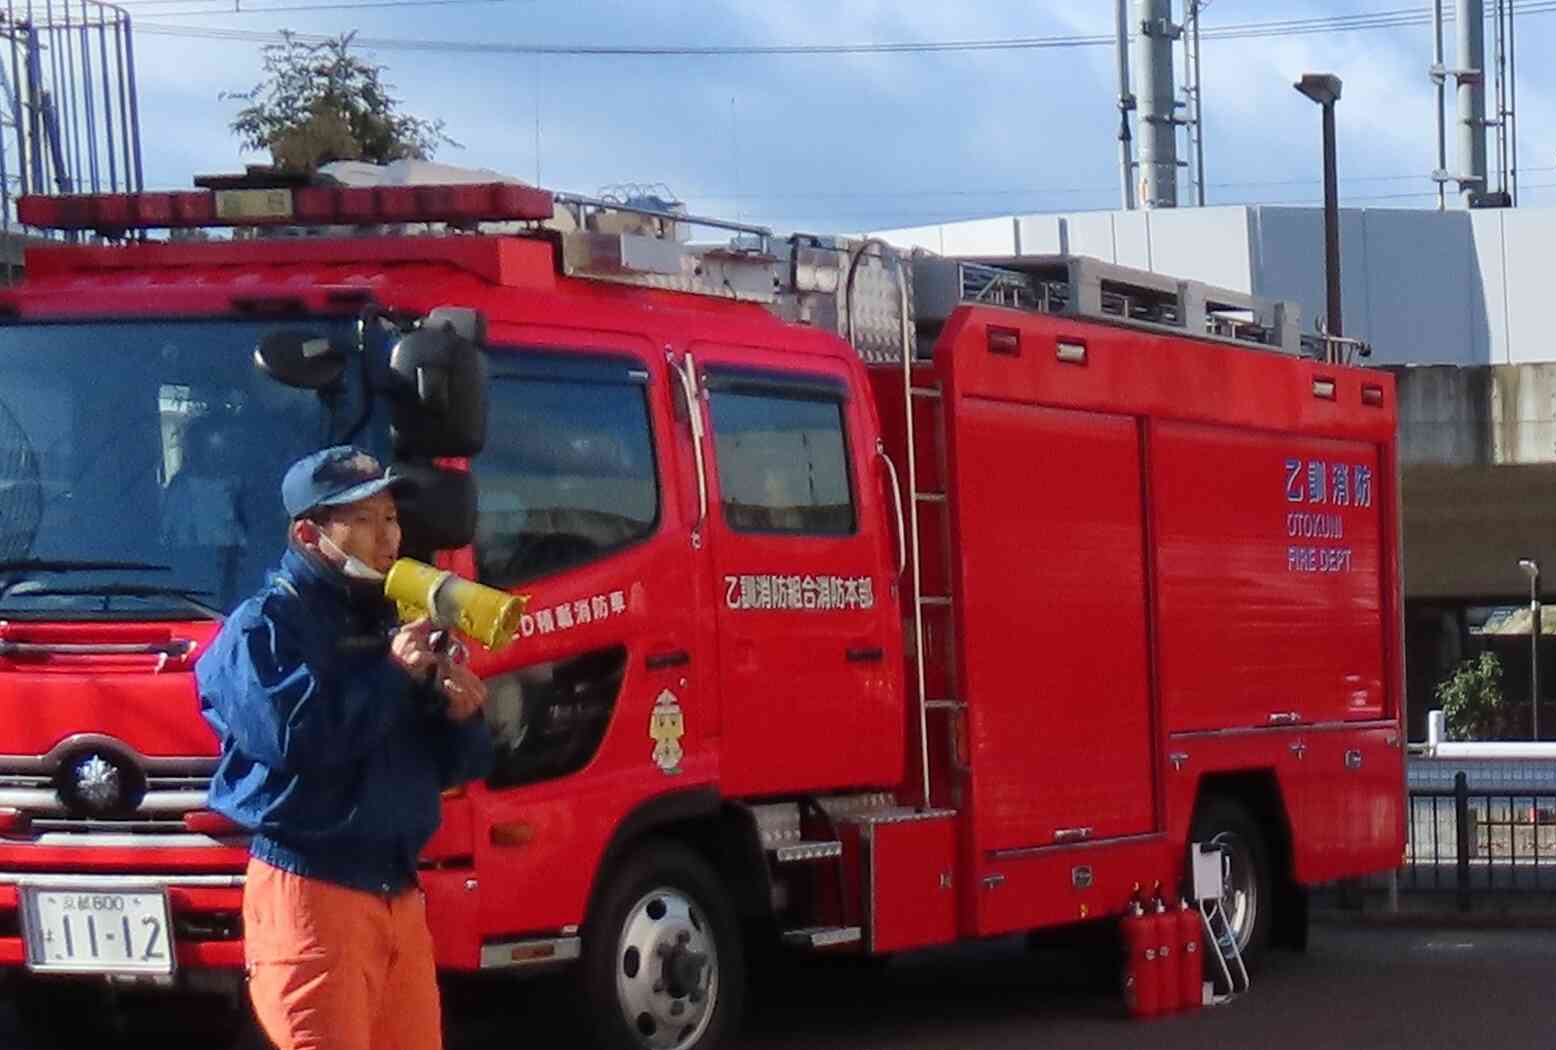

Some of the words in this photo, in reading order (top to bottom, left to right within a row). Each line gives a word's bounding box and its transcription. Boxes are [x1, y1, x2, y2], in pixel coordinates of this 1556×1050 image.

[1285, 458, 1371, 507] 乙訓消防
[1287, 547, 1316, 572] FIRE
[63, 914, 165, 961] 11-12
